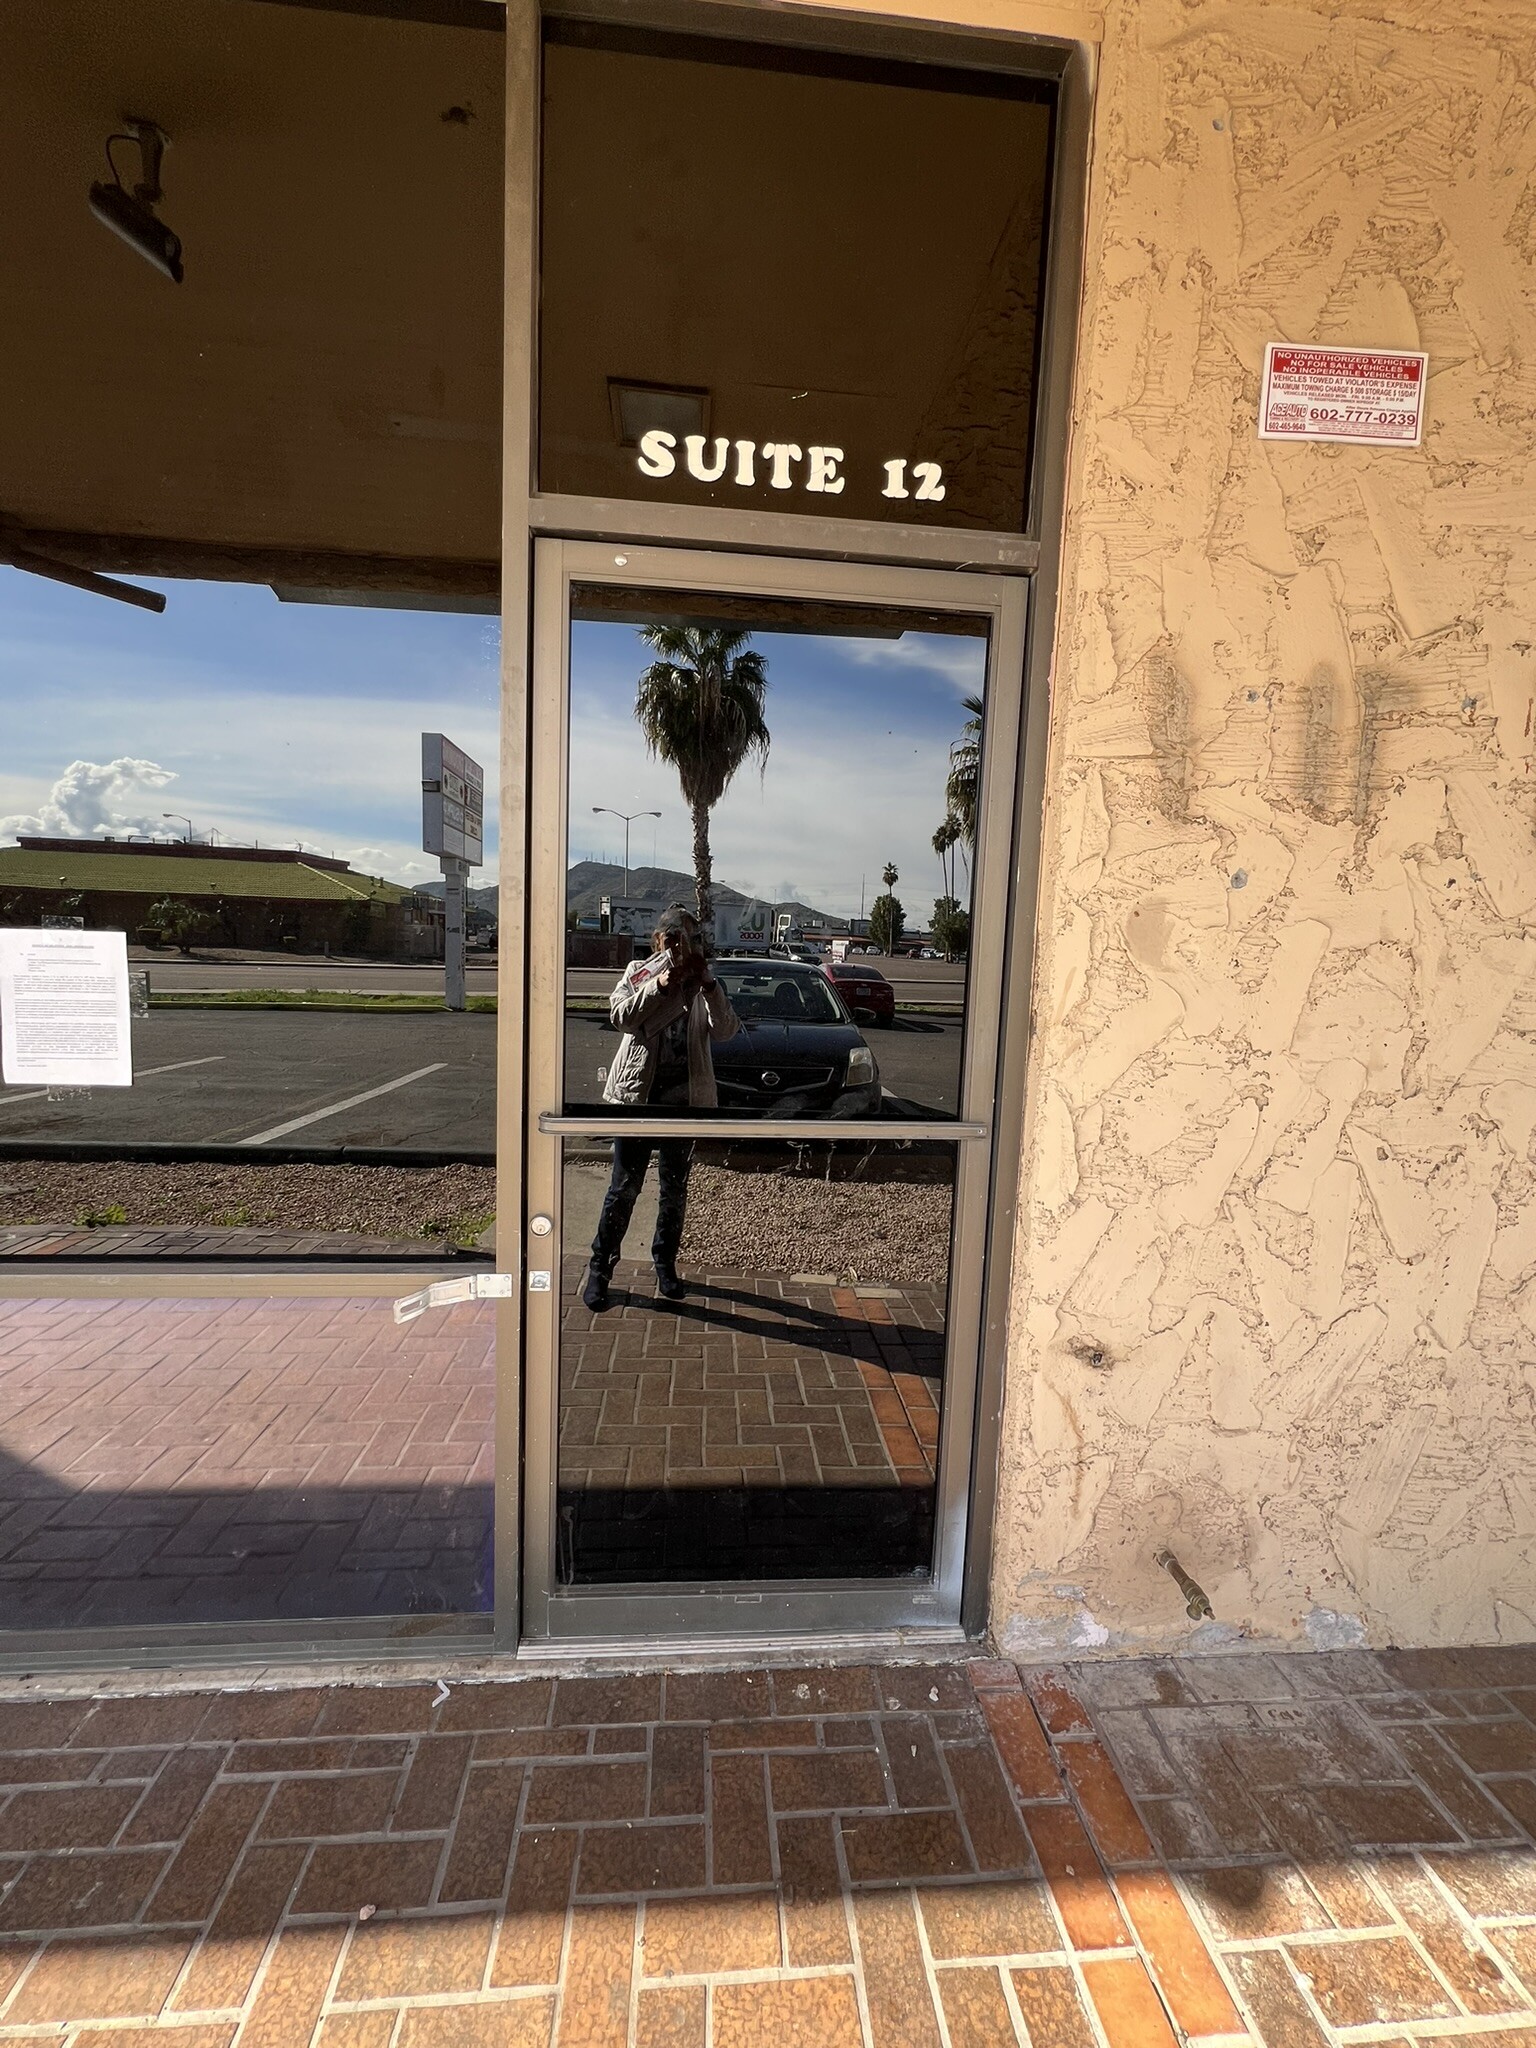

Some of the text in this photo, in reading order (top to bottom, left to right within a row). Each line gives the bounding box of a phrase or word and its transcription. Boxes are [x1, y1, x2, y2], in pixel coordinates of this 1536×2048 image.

[1294, 353, 1370, 364] UNAUTHORIZED
[1371, 358, 1417, 367] VEHICLES
[1299, 367, 1360, 376] INOPERABLE
[1363, 371, 1409, 380] VEHICLES
[1357, 364, 1403, 372] VEHICLES
[1272, 382, 1299, 390] MAXIMUM
[1325, 385, 1348, 393] CHARGE
[1273, 374, 1306, 382] VEHICLES
[1309, 376, 1333, 384] TOWED
[1345, 379, 1384, 387] VIOLATOR'S
[1386, 381, 1416, 389] EXPENSE
[1310, 408, 1415, 425] 602-777-0239
[638, 430, 946, 502] SUITE 12
